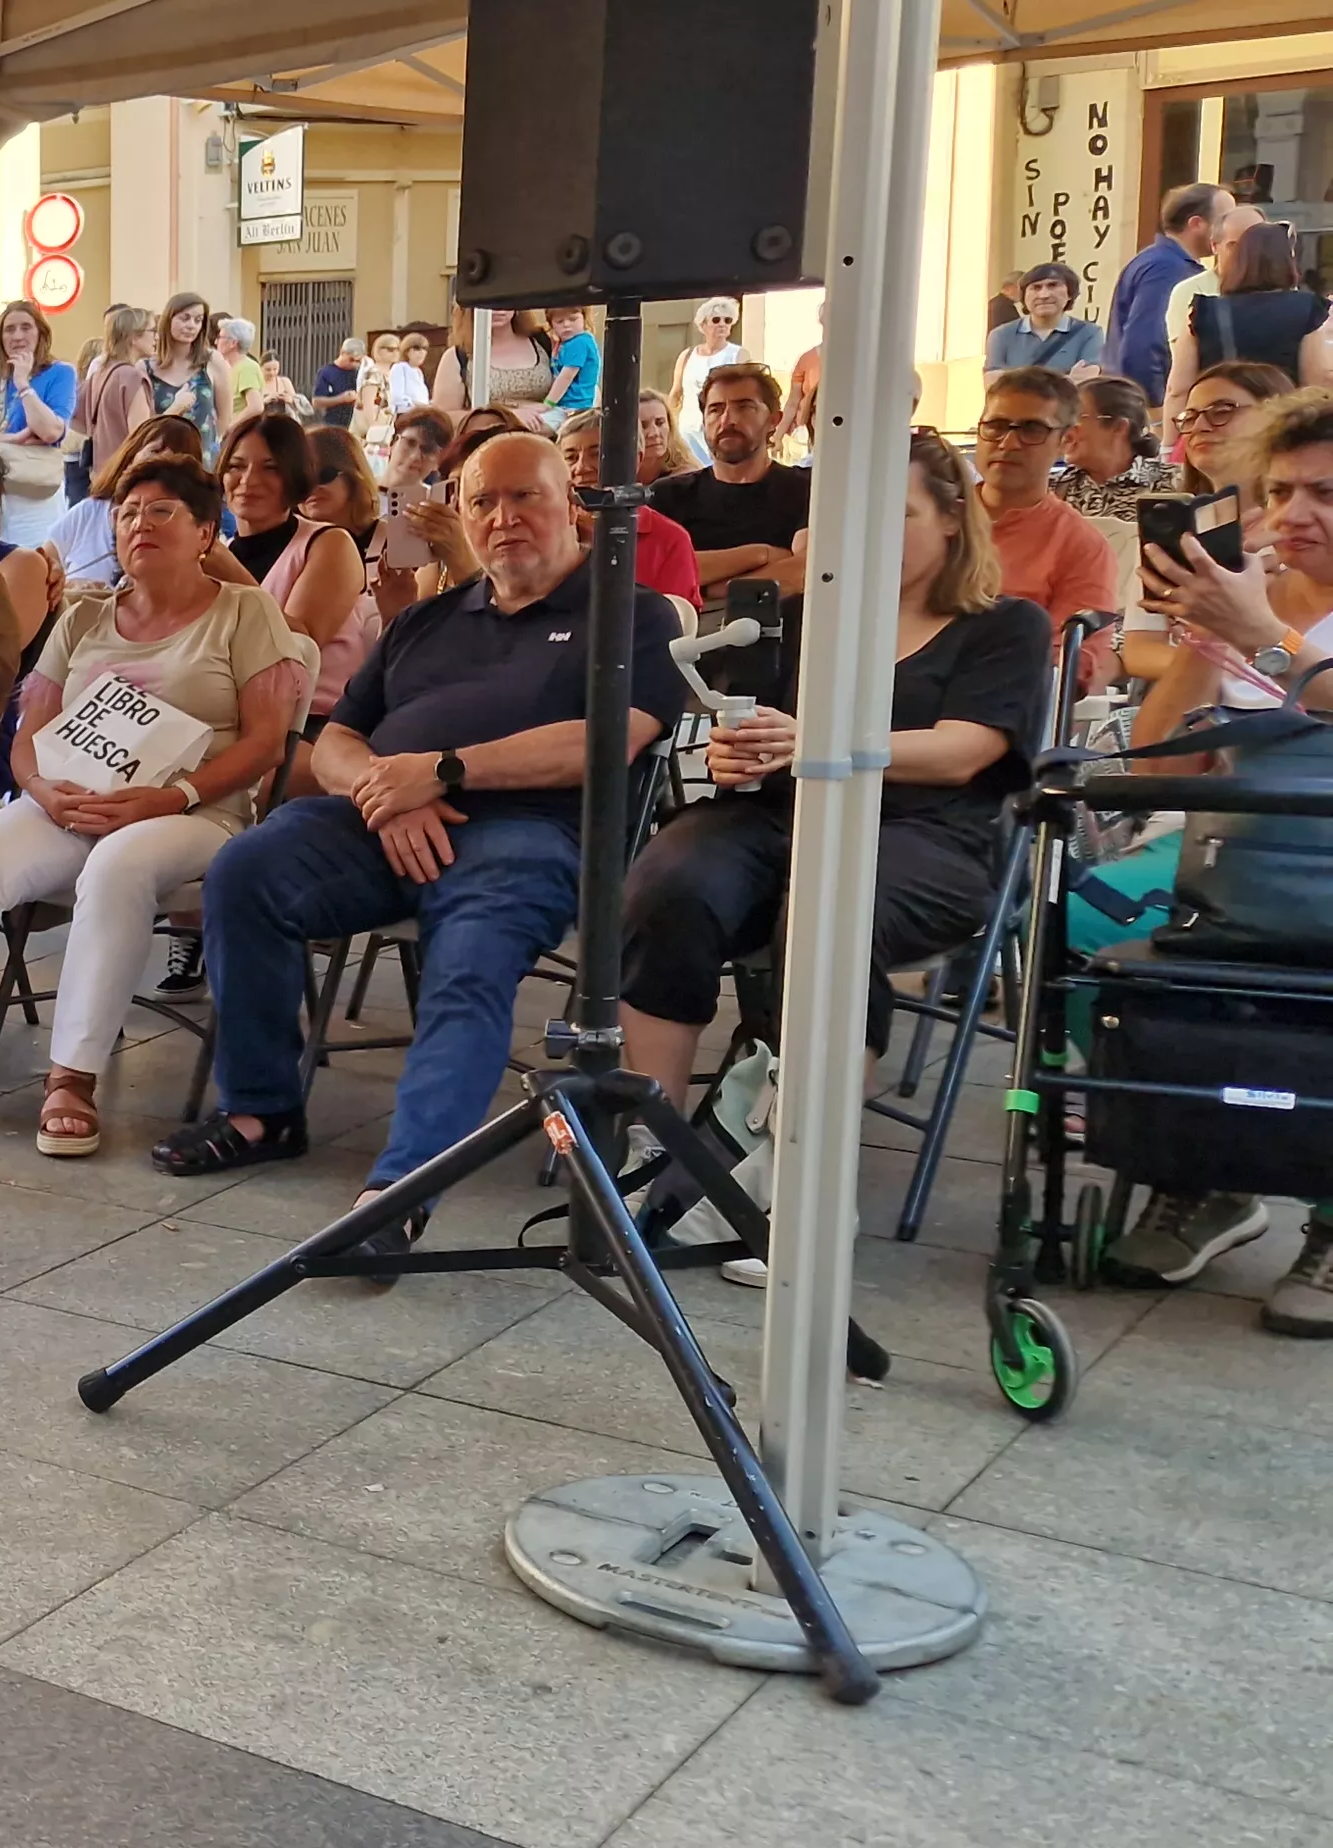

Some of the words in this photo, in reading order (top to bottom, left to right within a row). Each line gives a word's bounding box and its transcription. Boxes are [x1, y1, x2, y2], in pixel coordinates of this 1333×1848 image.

[1088, 101, 1108, 156] NO
[247, 177, 292, 195] VELTINS
[1021, 158, 1041, 238] SIN
[1092, 164, 1113, 249] HAY
[304, 204, 347, 228] ACENES
[305, 231, 339, 254] JUAN
[1049, 192, 1070, 264] POE
[1083, 261, 1100, 323] CIU
[75, 700, 112, 728] DE
[93, 681, 161, 727] LIBRO
[54, 719, 141, 784] HUESCA
